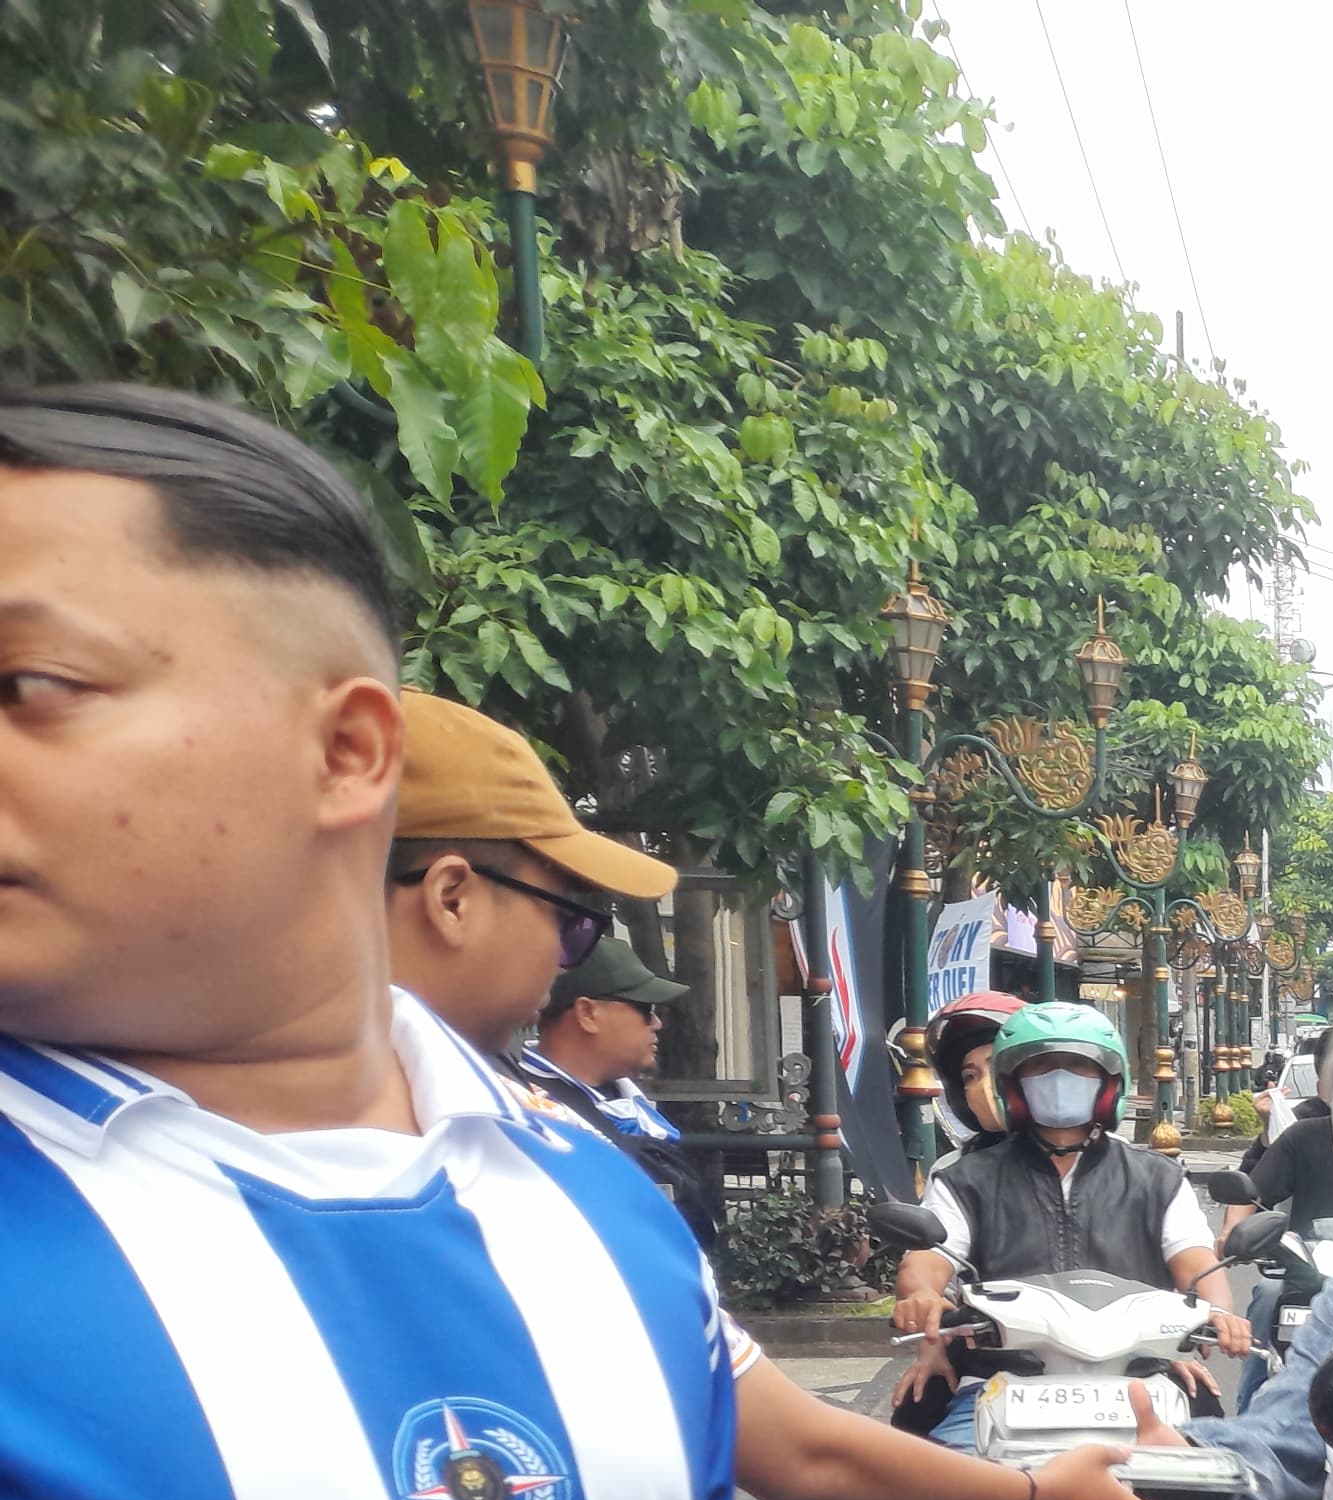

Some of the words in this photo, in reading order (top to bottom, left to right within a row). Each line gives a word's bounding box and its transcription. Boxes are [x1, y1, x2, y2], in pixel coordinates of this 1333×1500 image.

[1011, 1390, 1024, 1404] N
[1038, 1388, 1100, 1404] 4851
[1115, 1390, 1161, 1404] AH
